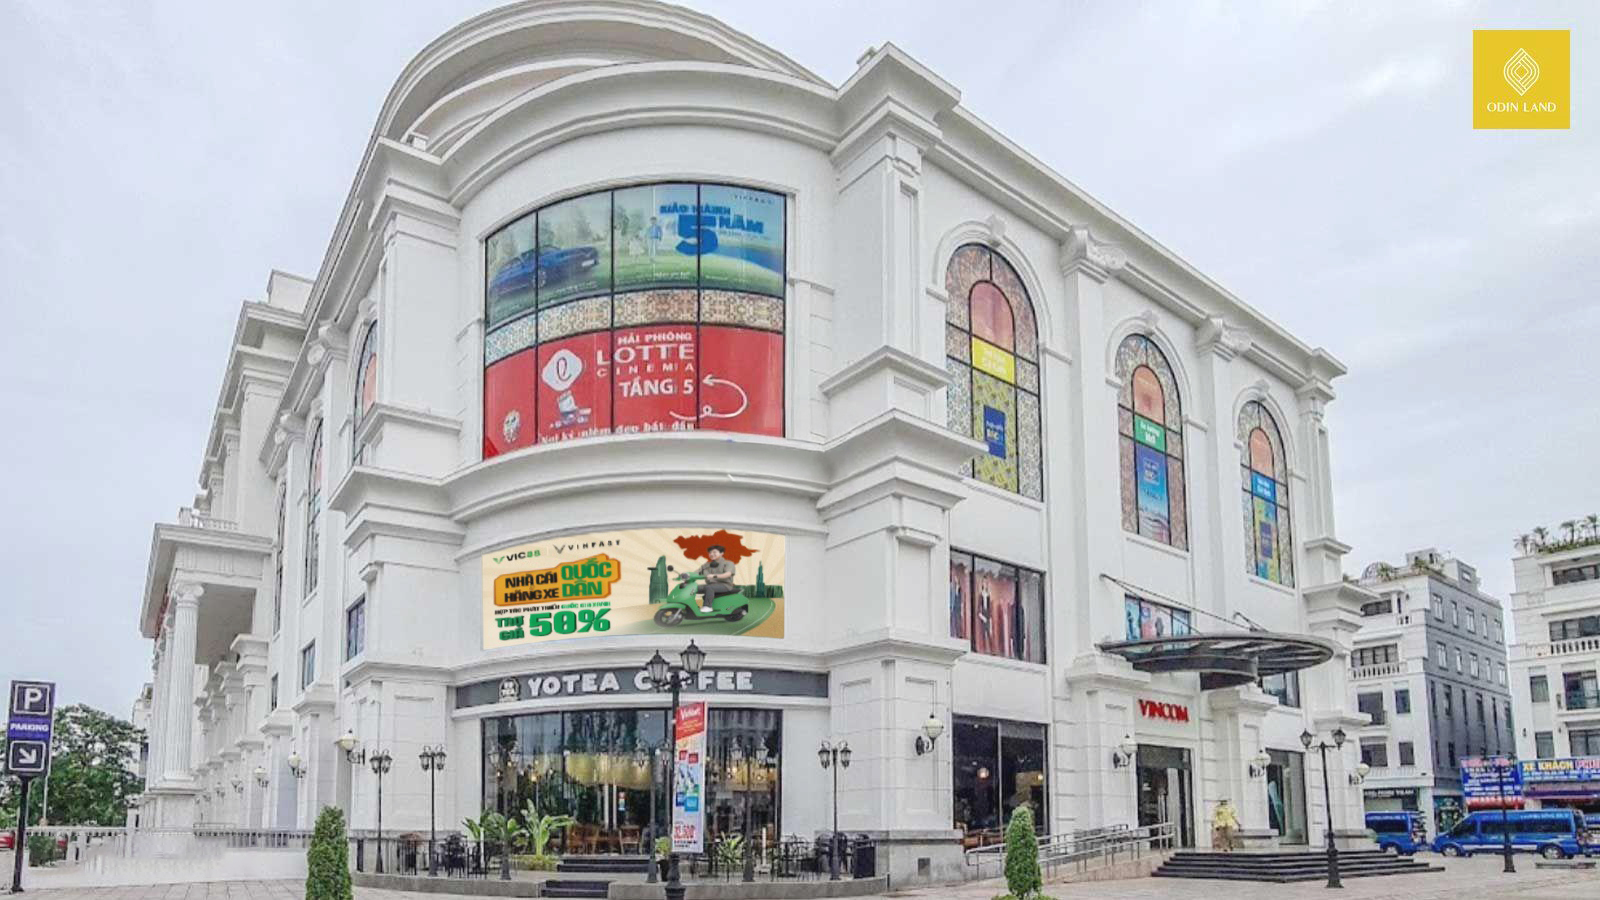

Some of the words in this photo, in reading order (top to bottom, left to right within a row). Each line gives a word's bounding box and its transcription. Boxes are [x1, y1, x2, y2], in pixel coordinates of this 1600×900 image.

[675, 214, 718, 256] 5
[596, 343, 695, 366] LOTTE
[596, 362, 695, 377] CINEMA
[683, 379, 695, 395] 5
[568, 540, 621, 551] VINFAST
[561, 557, 612, 580] QUỐC
[505, 573, 534, 588] NHÀ
[562, 577, 602, 598] DÂN
[543, 587, 559, 598] XE
[529, 608, 612, 637] 50%
[527, 672, 620, 697] YOTEA
[24, 687, 42, 710] P
[1138, 698, 1189, 723] VINCOM
[10, 722, 49, 732] PARKING
